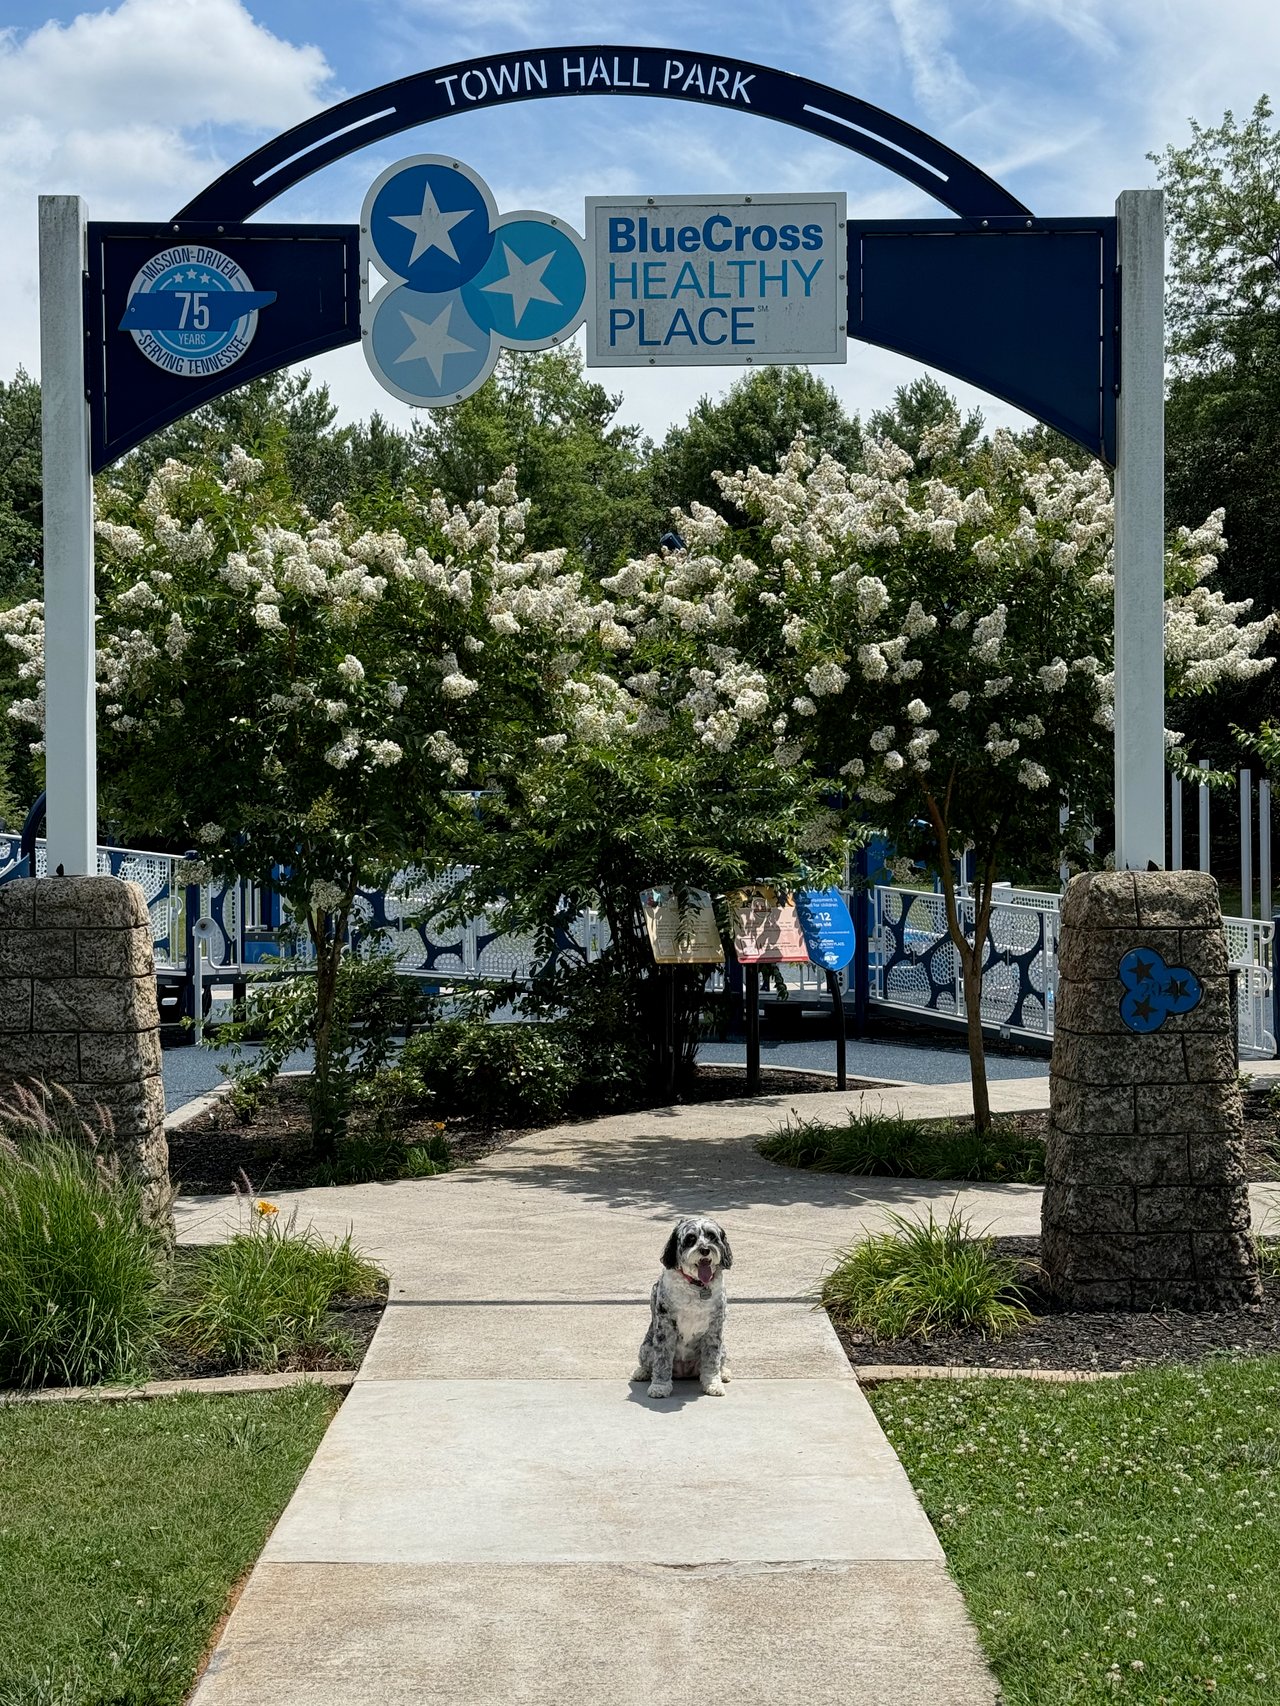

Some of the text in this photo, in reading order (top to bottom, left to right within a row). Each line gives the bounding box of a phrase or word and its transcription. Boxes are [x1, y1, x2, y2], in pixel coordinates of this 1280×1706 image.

[435, 56, 756, 106] TOWN HALL PARK
[608, 214, 824, 253] BlueCross
[141, 247, 240, 282] MISSION-DRIVEN
[608, 258, 825, 300] HEALTHY
[174, 292, 210, 330] 75
[609, 306, 756, 347] PLACE
[138, 334, 249, 375] SERVING TENNESSEE
[178, 333, 206, 345] YEARS
